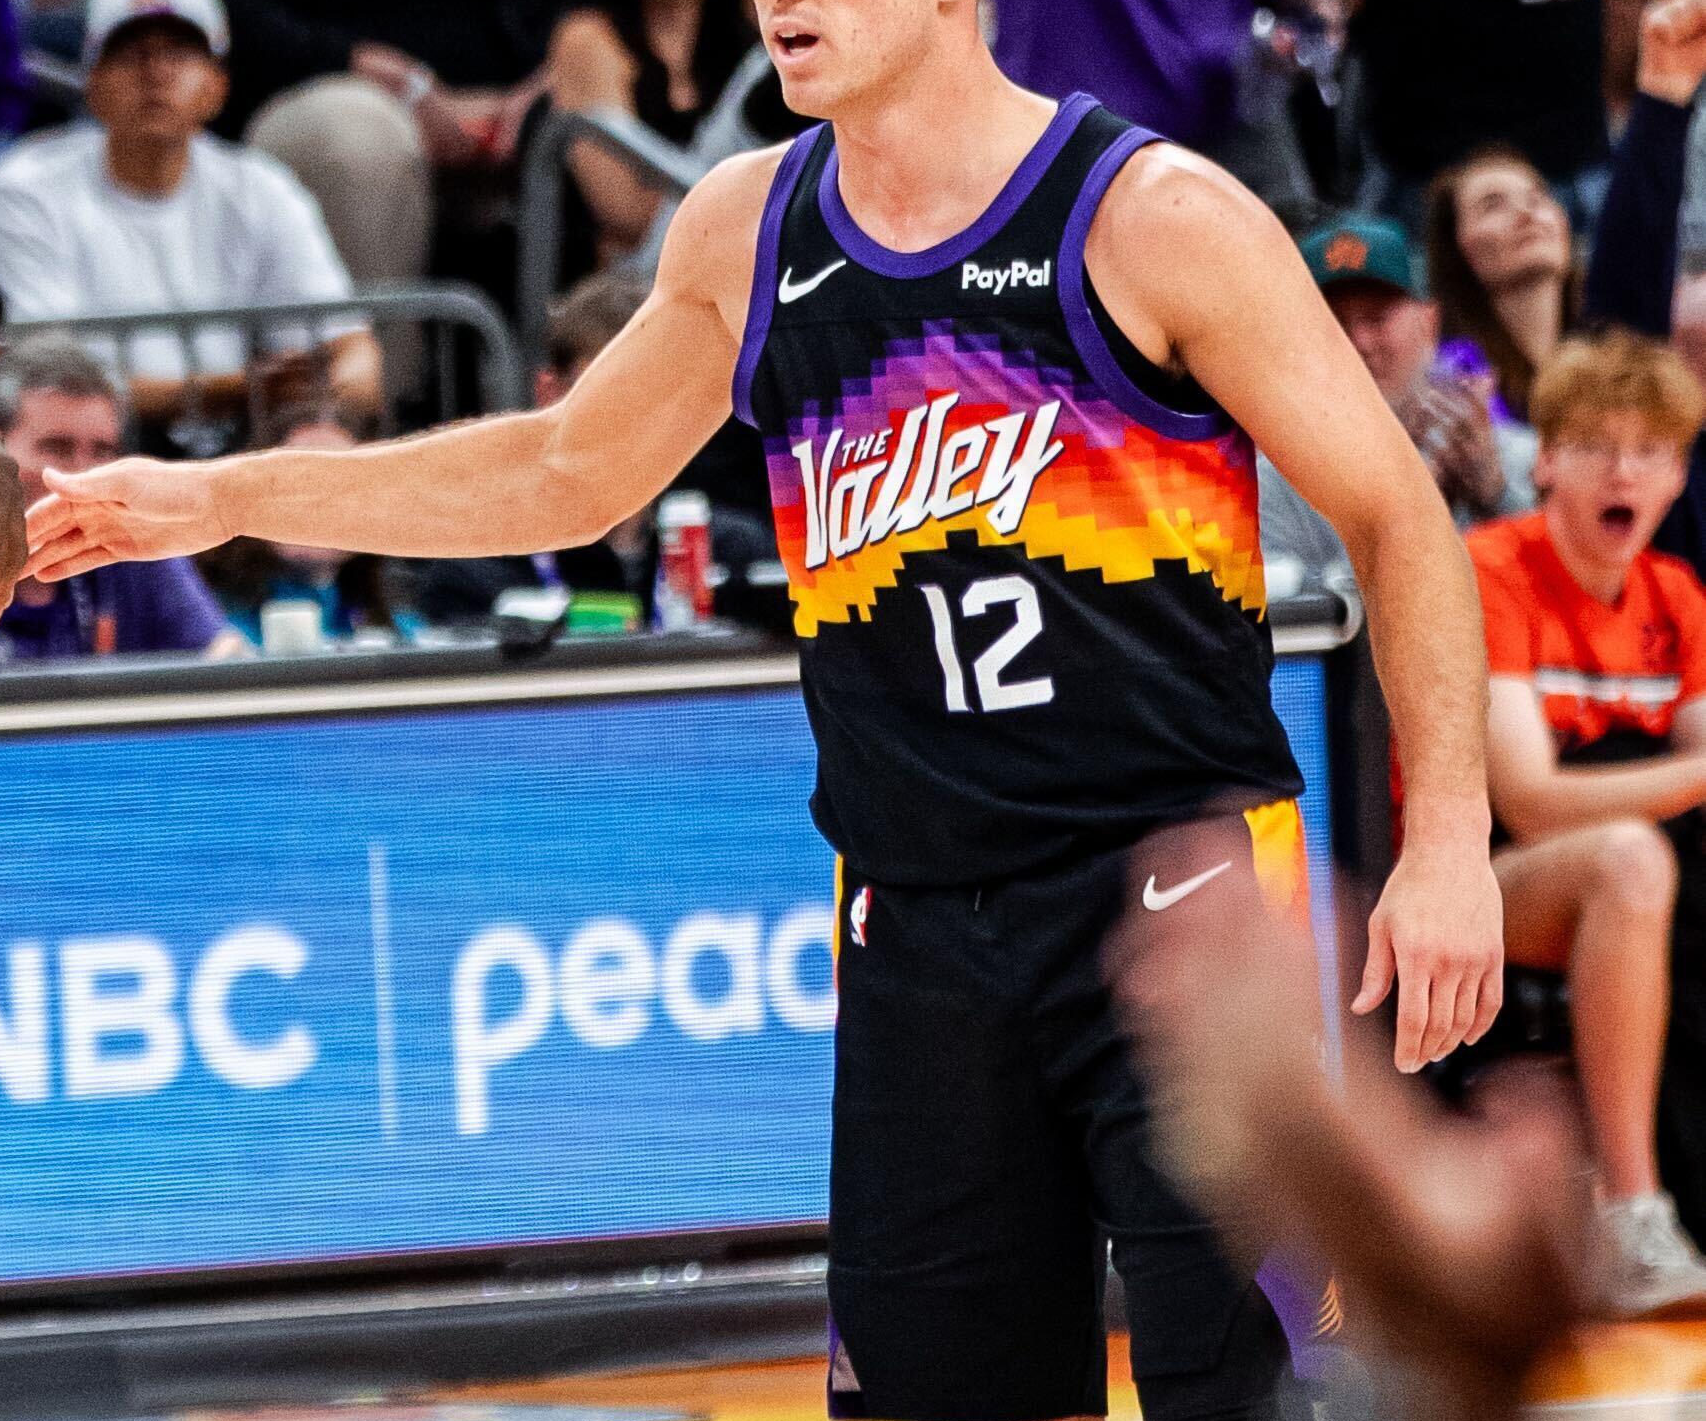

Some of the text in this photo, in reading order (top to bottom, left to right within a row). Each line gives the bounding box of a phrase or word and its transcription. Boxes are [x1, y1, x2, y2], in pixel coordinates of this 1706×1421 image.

[961, 259, 1051, 295] PayPal
[791, 392, 1066, 571] Valley
[840, 427, 894, 468] THE
[918, 574, 1055, 714] 12
